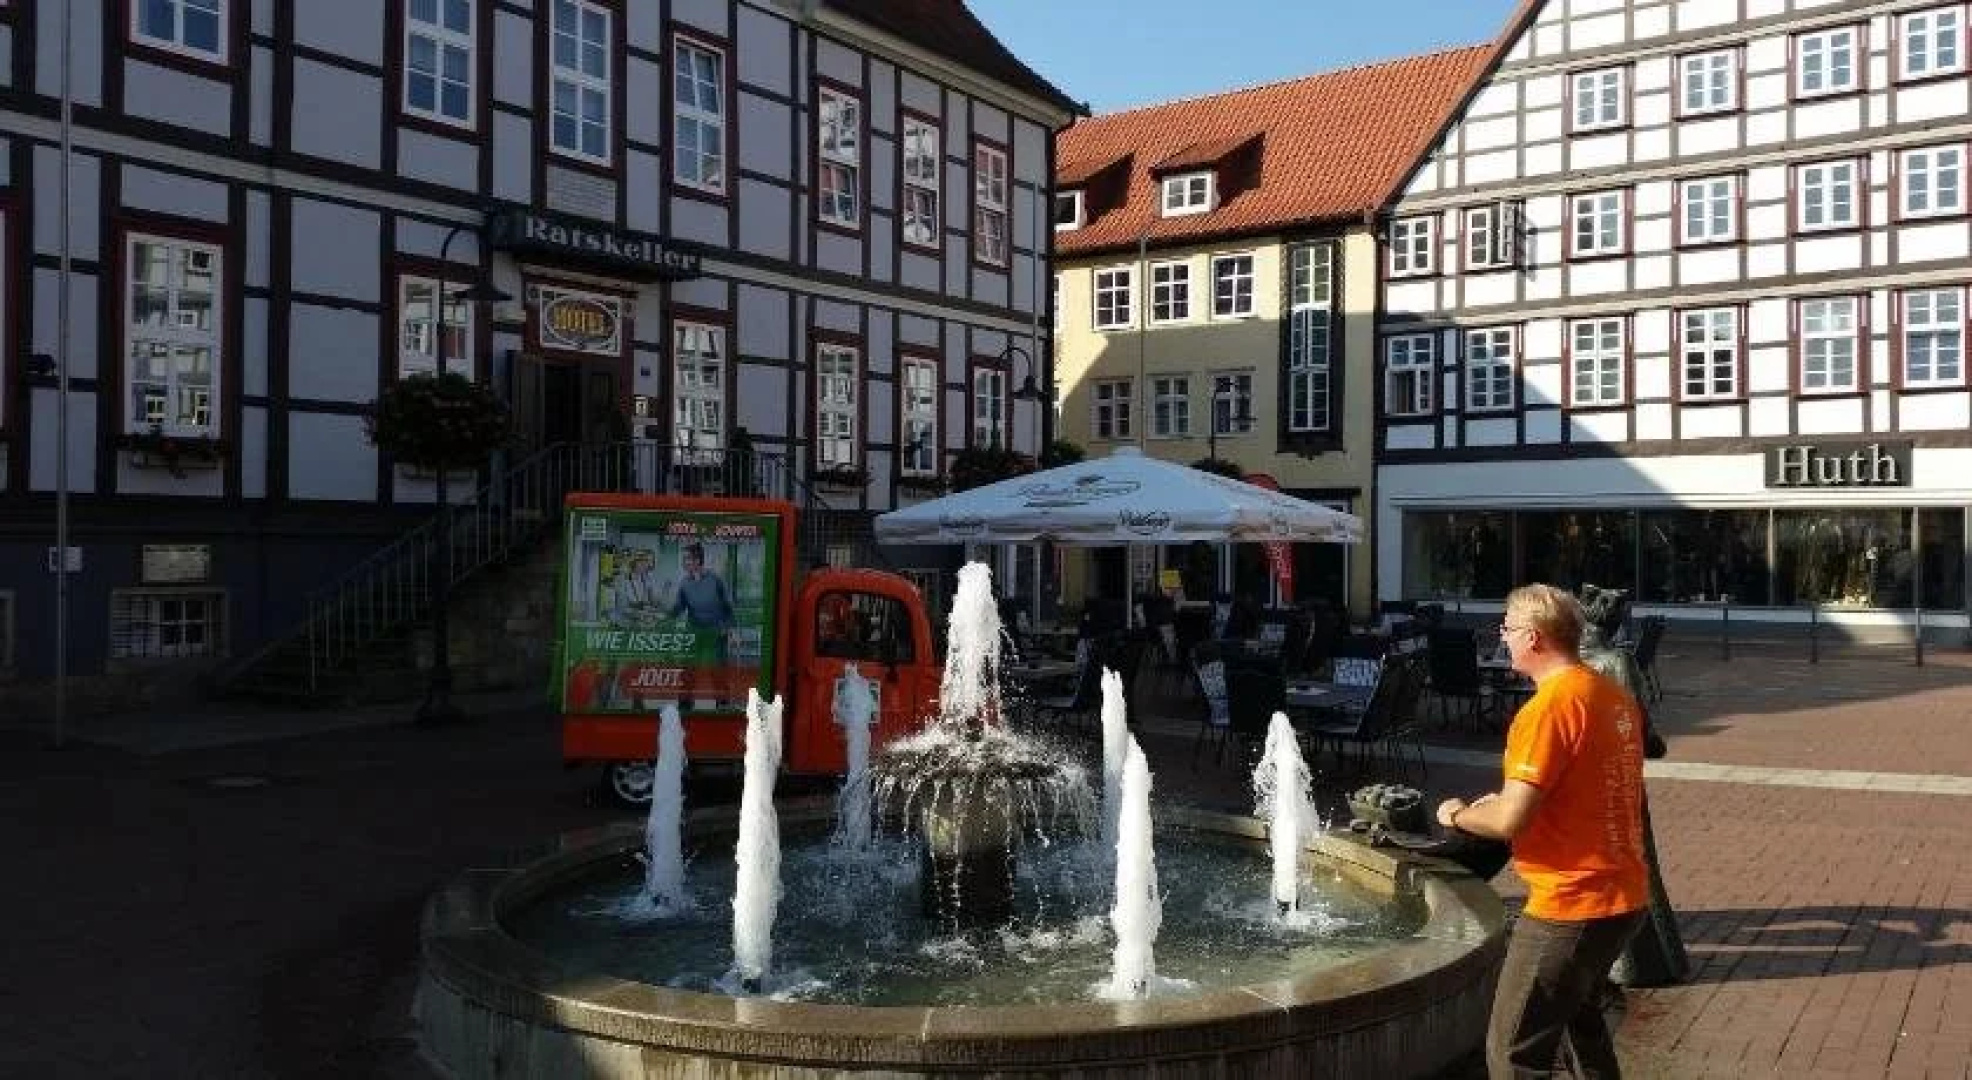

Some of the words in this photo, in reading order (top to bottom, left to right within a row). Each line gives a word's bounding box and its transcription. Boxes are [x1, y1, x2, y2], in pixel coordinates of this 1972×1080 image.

[525, 216, 697, 271] Ratskeller
[553, 305, 605, 335] HOTEL
[1774, 443, 1898, 485] Huth
[586, 631, 625, 649] WIE
[628, 632, 696, 651] ISSES?
